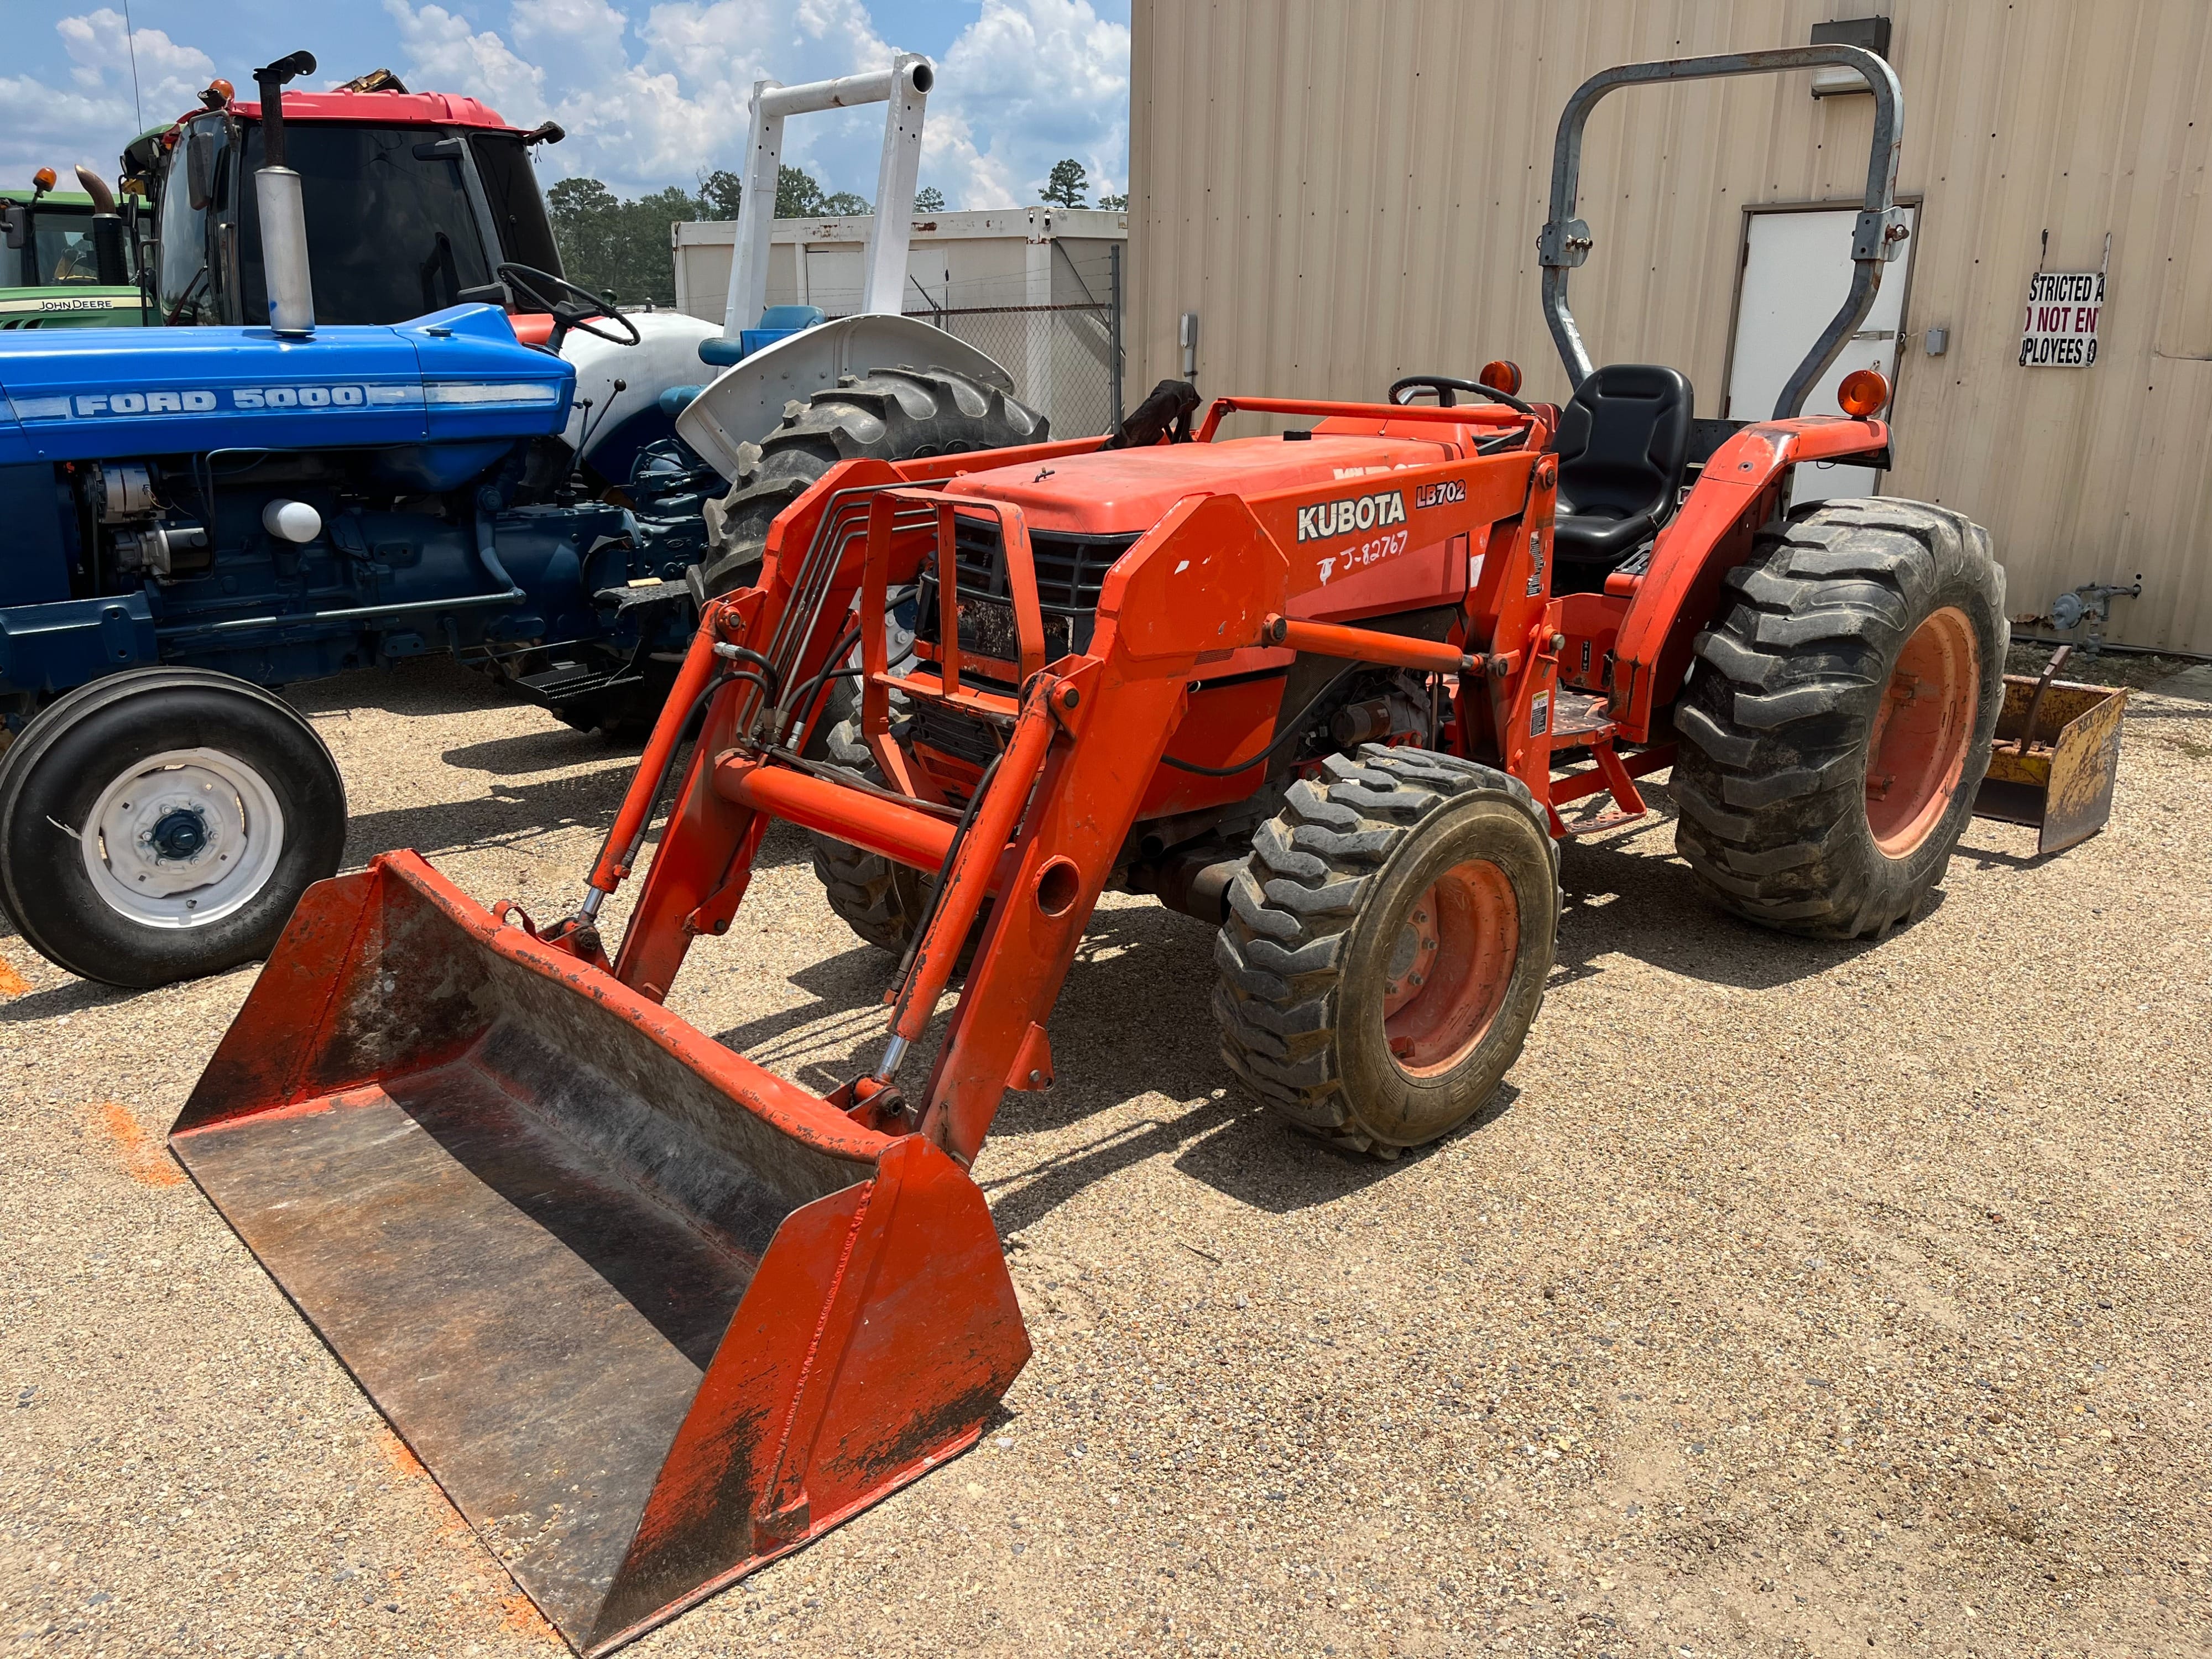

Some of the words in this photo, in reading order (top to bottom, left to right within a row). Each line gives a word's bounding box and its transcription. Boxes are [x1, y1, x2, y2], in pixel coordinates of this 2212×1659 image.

[2030, 276, 2092, 301] STRICTED
[2094, 276, 2105, 301] A
[39, 301, 71, 311] JOHN
[73, 300, 113, 309] DEERE
[2037, 306, 2072, 332] NOT
[2075, 307, 2099, 332] EN
[76, 390, 217, 415] FORD
[233, 387, 363, 408] 5000
[1297, 490, 1407, 543] KUBOTA
[1416, 479, 1465, 509] LB702
